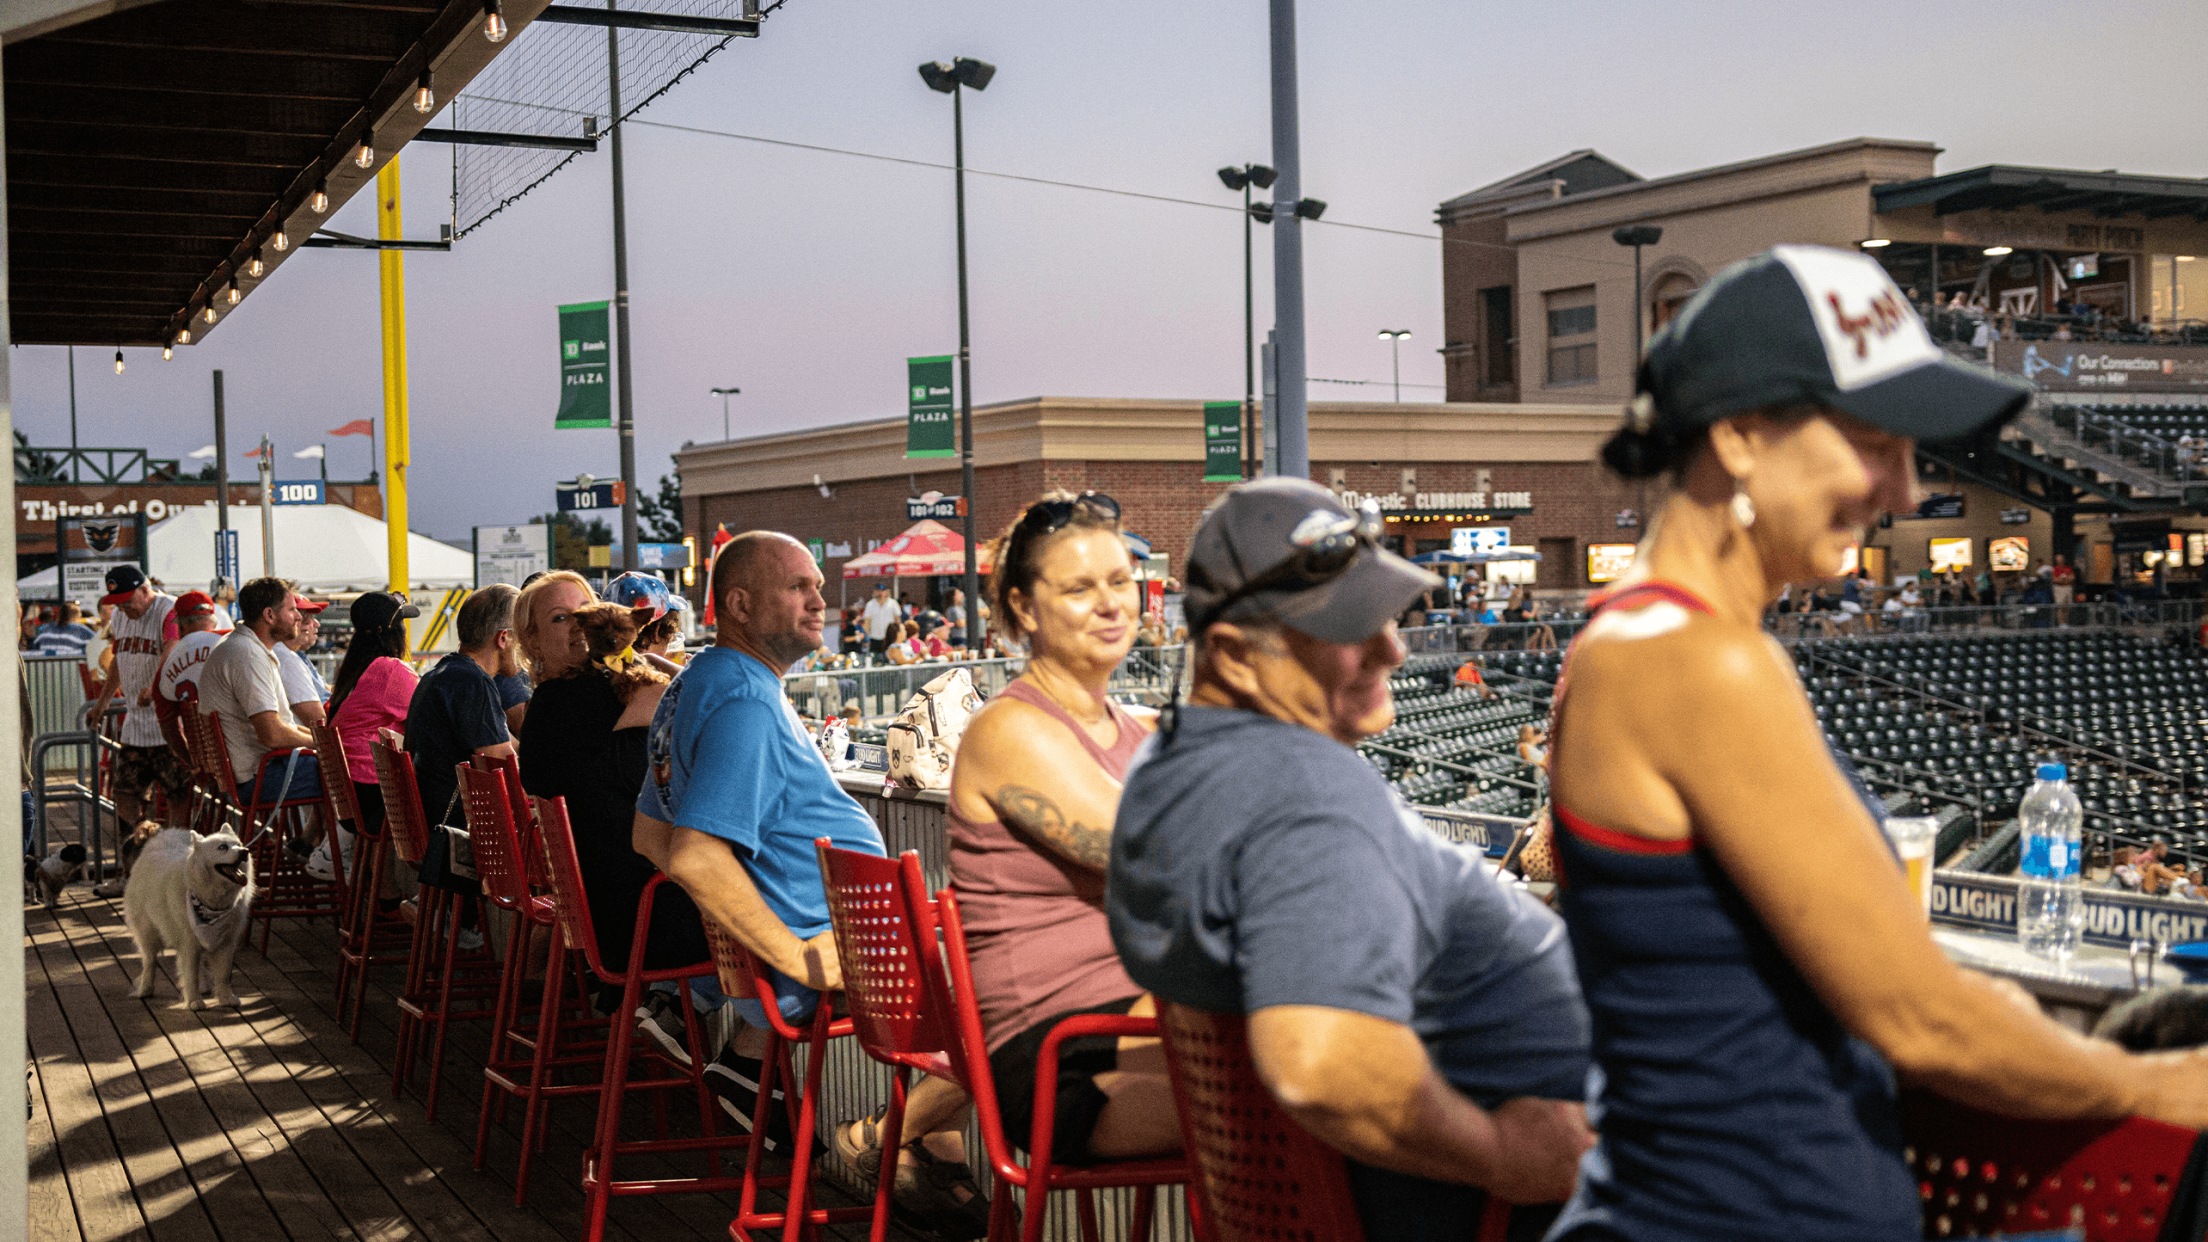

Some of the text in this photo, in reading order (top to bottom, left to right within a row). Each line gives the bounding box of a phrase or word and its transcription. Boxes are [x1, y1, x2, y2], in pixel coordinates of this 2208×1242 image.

[566, 340, 606, 357] TD Bank
[2077, 354, 2099, 370] Our
[566, 373, 603, 386] PLAZA
[913, 412, 949, 423] PLAZA
[1209, 446, 1237, 454] PLAZA
[280, 484, 317, 501] 100
[574, 491, 597, 508] 101
[1342, 491, 1531, 510] Mastic CLUBHOUSE STORE
[21, 500, 104, 521] Thirst
[145, 499, 184, 521] Ou
[825, 541, 852, 558] Bank
[166, 646, 210, 683] HALLAD
[1451, 822, 1487, 845] LIGHT
[1949, 886, 2015, 922] LIGHT
[2127, 909, 2207, 942] LIGHT
